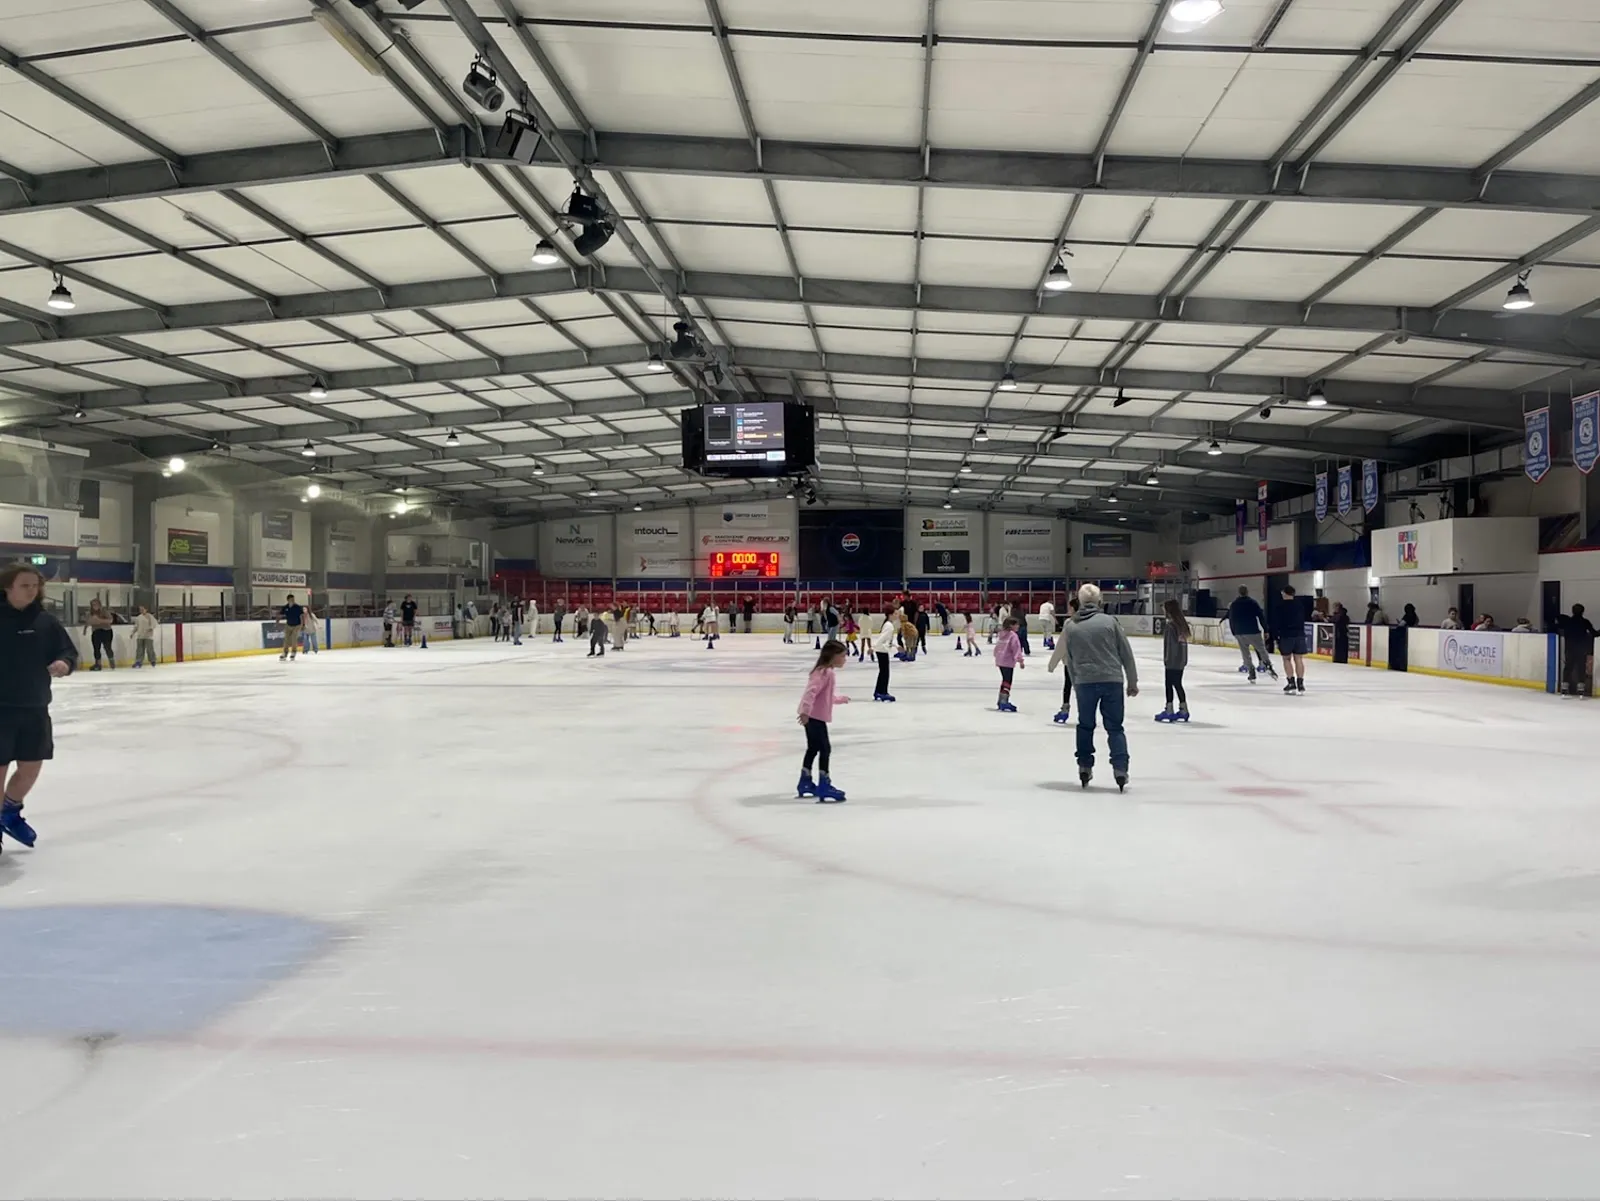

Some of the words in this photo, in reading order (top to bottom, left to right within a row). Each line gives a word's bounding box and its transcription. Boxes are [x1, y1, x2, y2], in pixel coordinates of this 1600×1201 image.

[24, 526, 48, 537] NEWS
[555, 536, 594, 544] NewSure
[716, 553, 724, 564] 0
[770, 553, 778, 564] 0
[257, 573, 289, 583] CHAMPAGNE
[289, 575, 305, 584] STAND
[1458, 645, 1497, 658] NEWCASTLE
